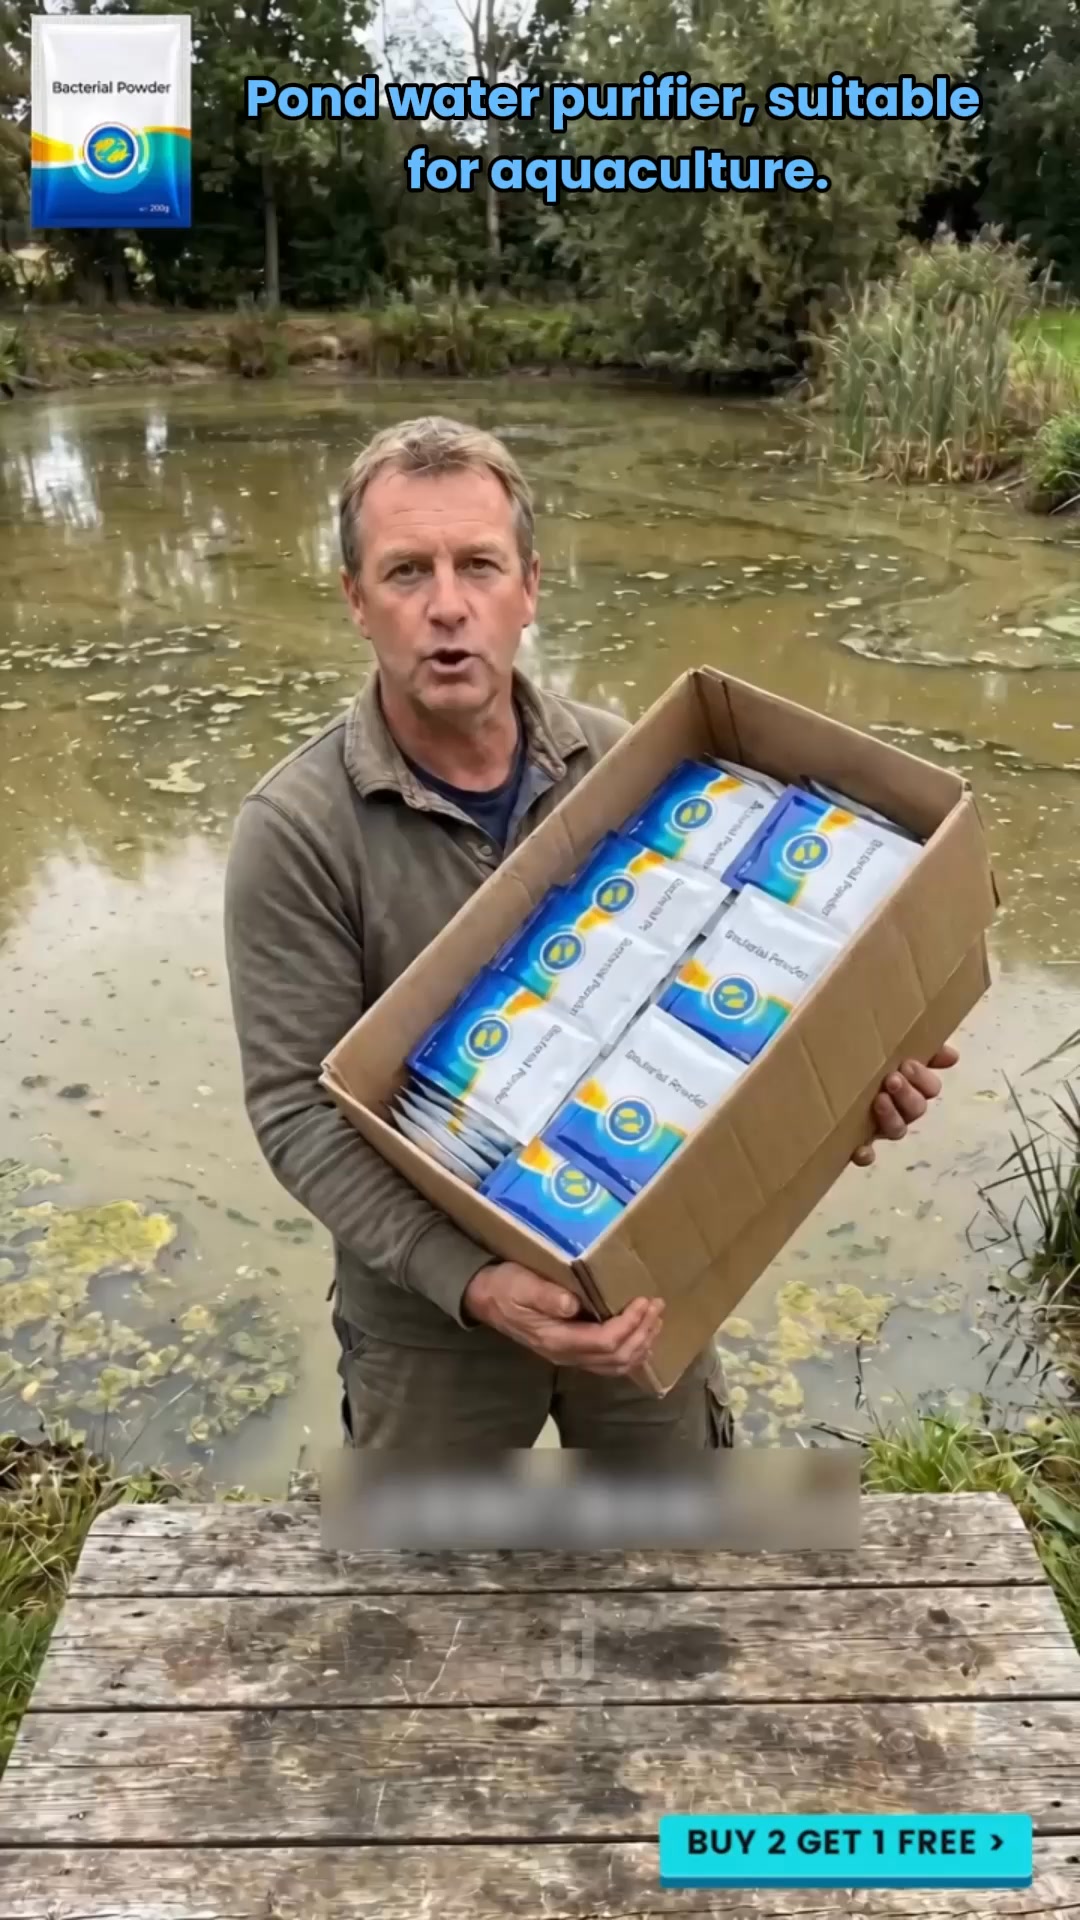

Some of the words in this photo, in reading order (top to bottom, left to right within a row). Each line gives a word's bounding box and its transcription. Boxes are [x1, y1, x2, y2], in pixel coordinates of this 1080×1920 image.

[53, 81, 113, 94] Bacterial
[117, 81, 171, 94] Powder
[149, 203, 170, 214] 200g
